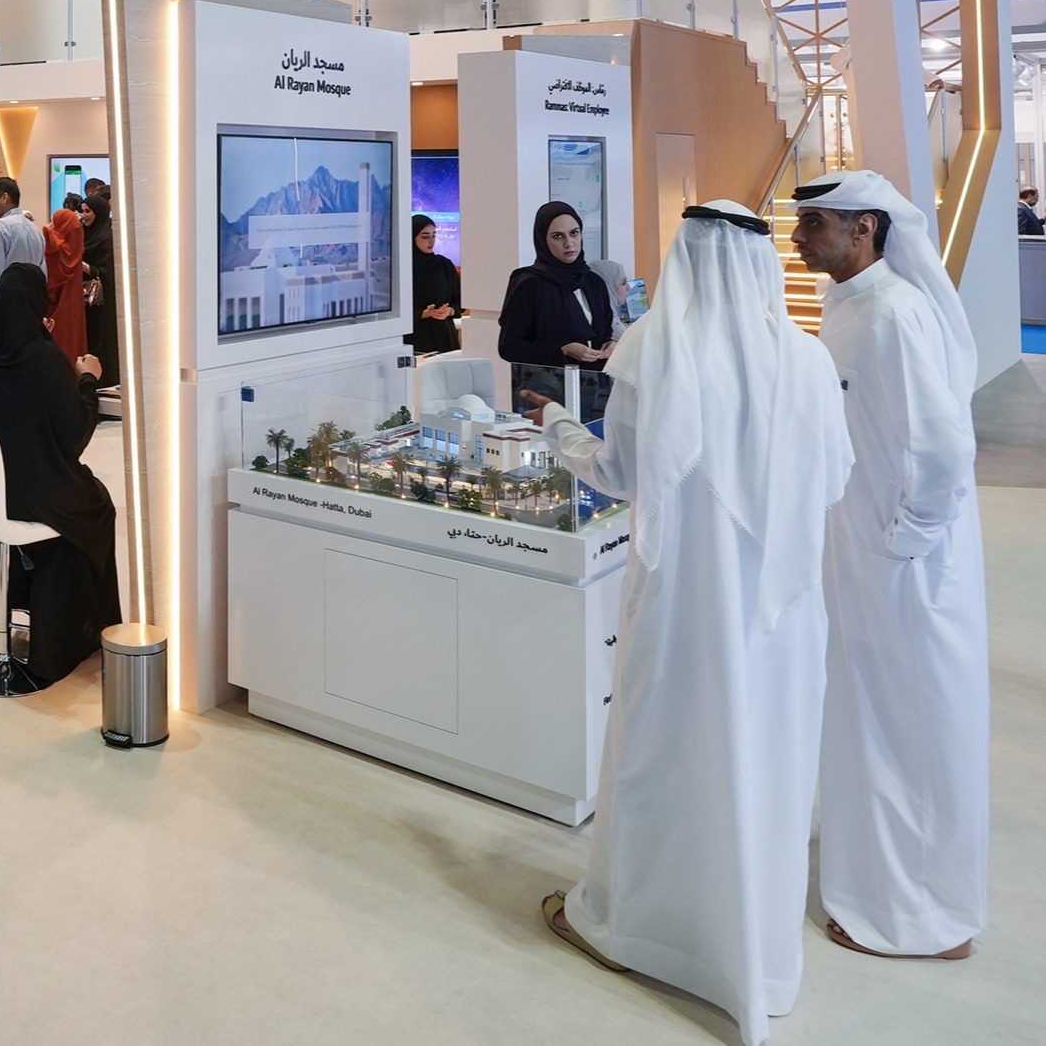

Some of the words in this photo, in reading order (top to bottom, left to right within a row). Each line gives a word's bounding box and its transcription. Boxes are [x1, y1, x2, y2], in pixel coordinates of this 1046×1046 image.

[281, 48, 310, 72] الريان
[313, 57, 344, 75] مسجد
[274, 75, 285, 89] Al
[287, 76, 315, 95] Rayan
[317, 79, 351, 98] Mosque
[253, 487, 260, 495] Al
[262, 488, 286, 500] Rayan
[288, 494, 318, 507] Mosque
[320, 501, 346, 514] -Hatta,
[348, 506, 372, 518] Dubai
[447, 529, 462, 539] دبي
[618, 533, 630, 545] Mosq
[516, 541, 548, 554] مسجد
